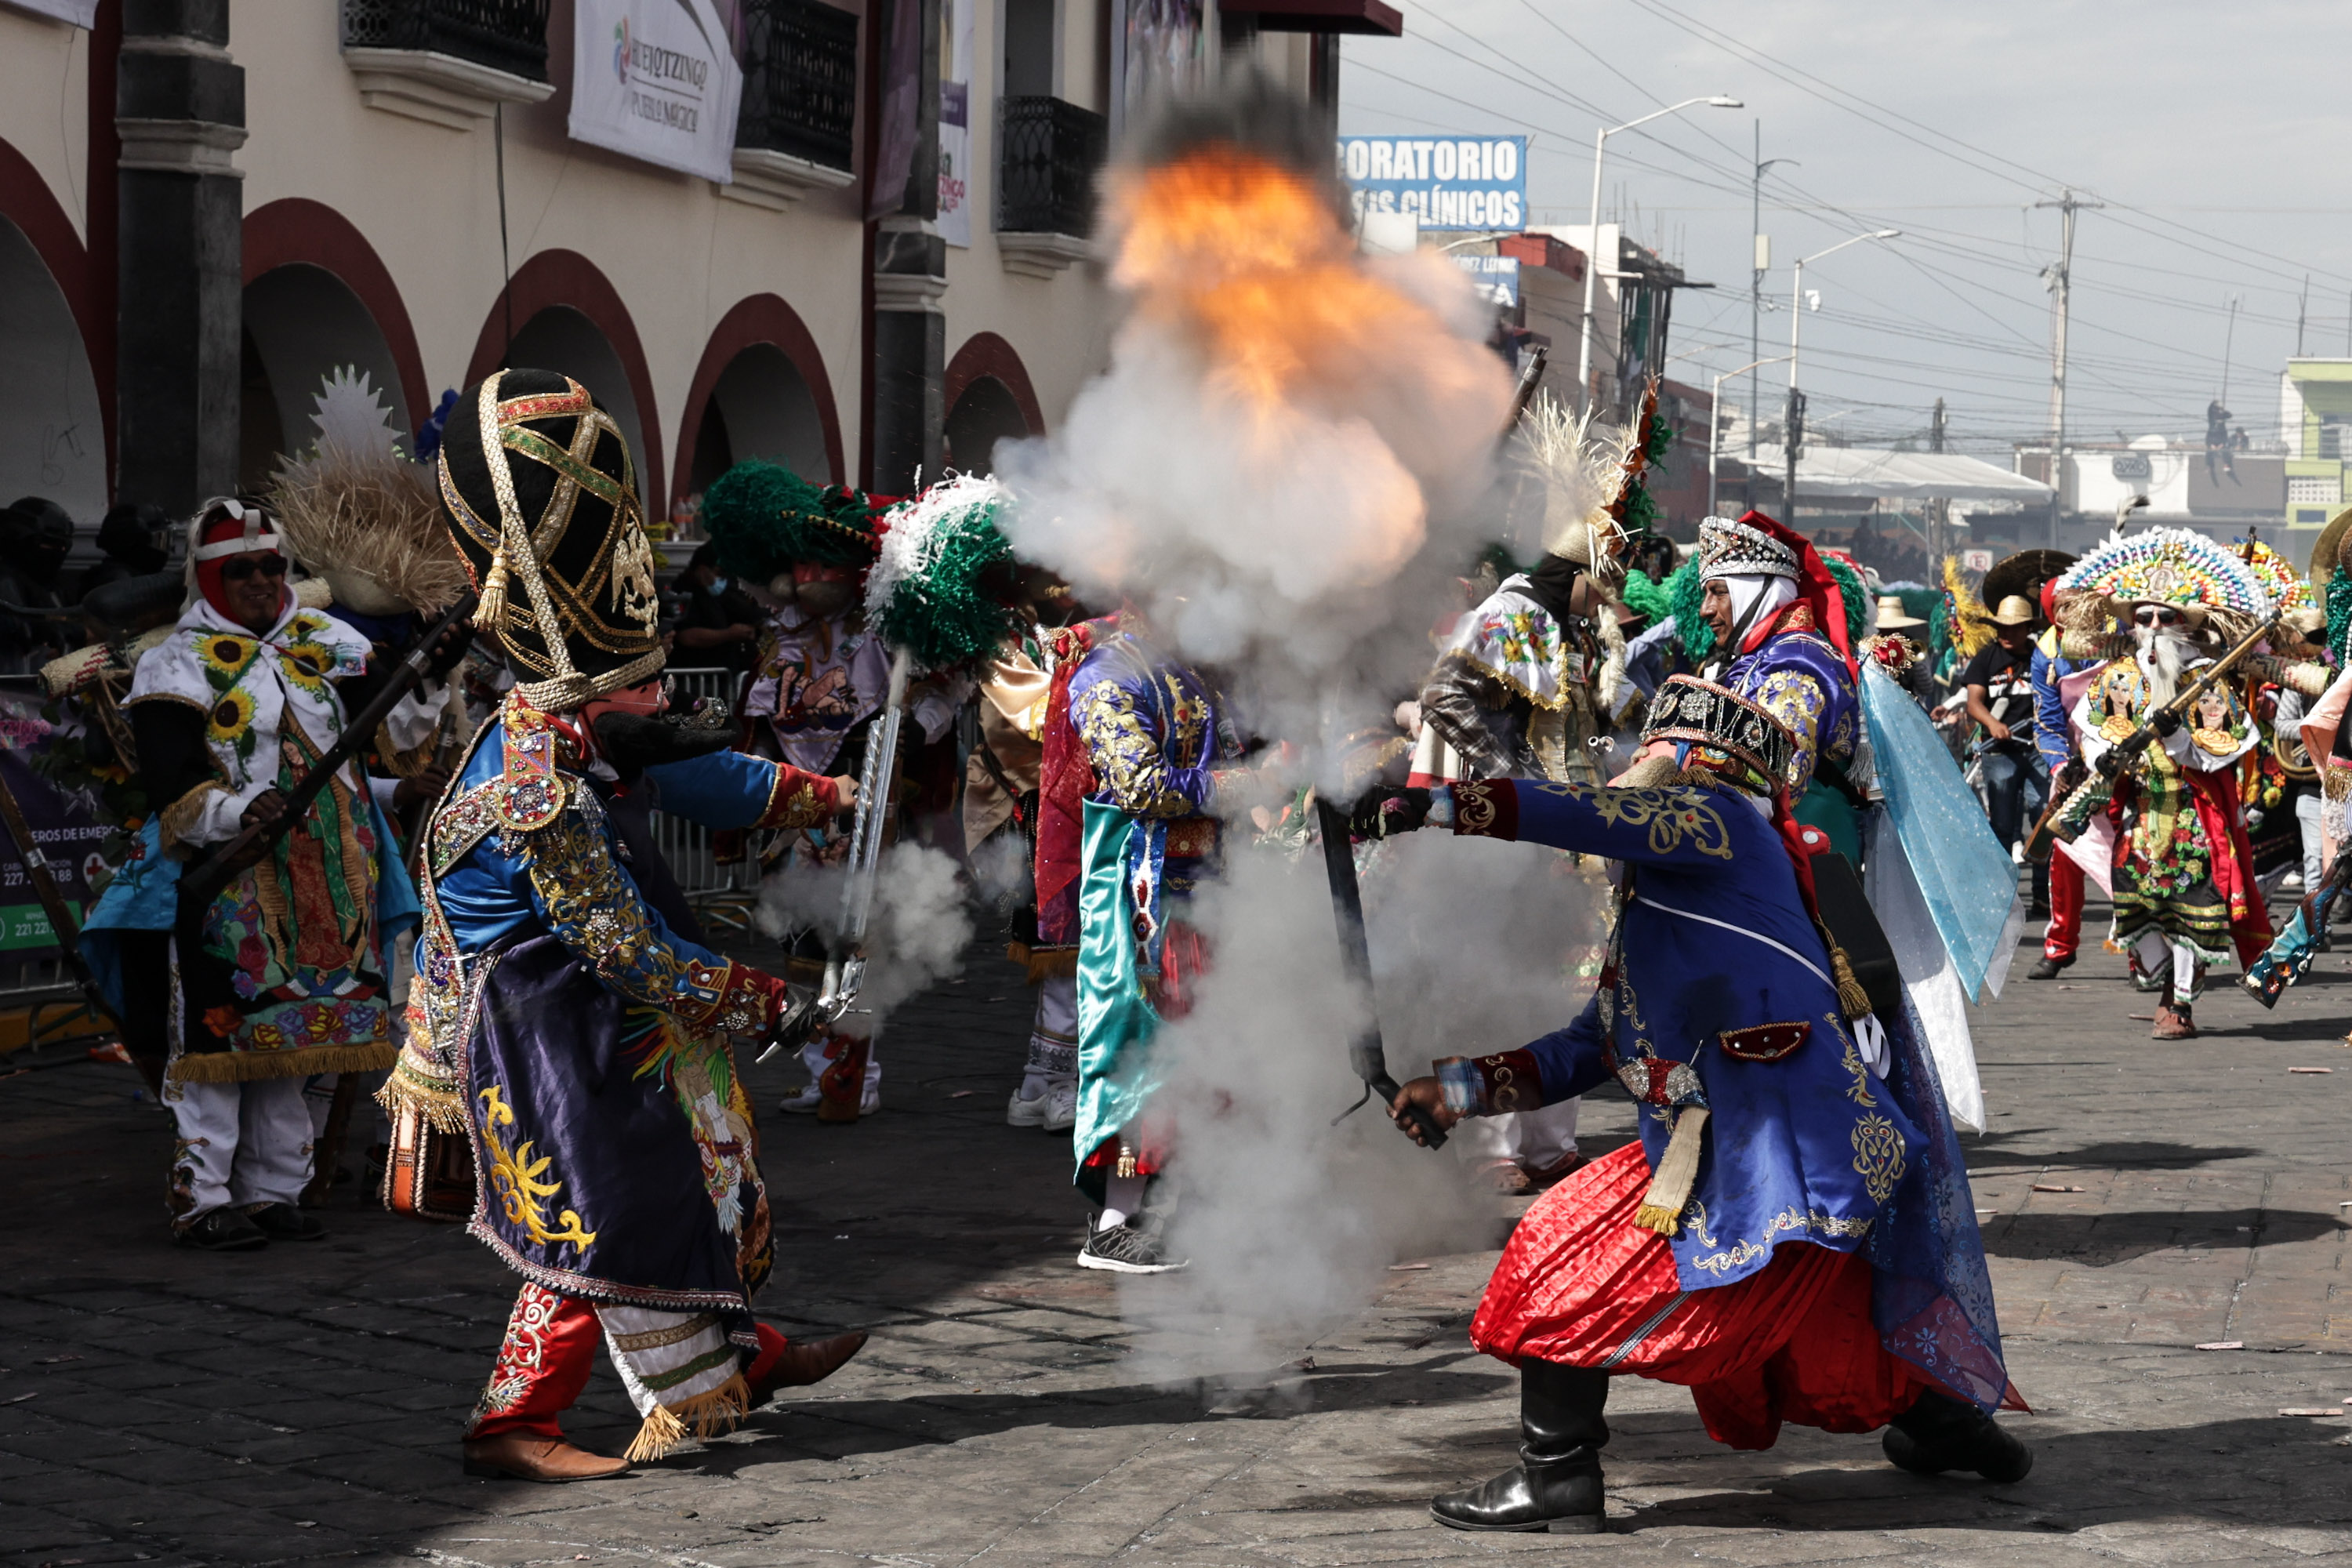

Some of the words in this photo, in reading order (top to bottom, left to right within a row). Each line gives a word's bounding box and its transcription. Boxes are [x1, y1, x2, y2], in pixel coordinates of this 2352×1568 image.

[630, 37, 708, 91] HUEJOTZINGO
[1400, 184, 1521, 227] CLÍNICOS
[63, 828, 77, 840] DE
[4, 872, 24, 887] 227
[58, 869, 72, 882] 88
